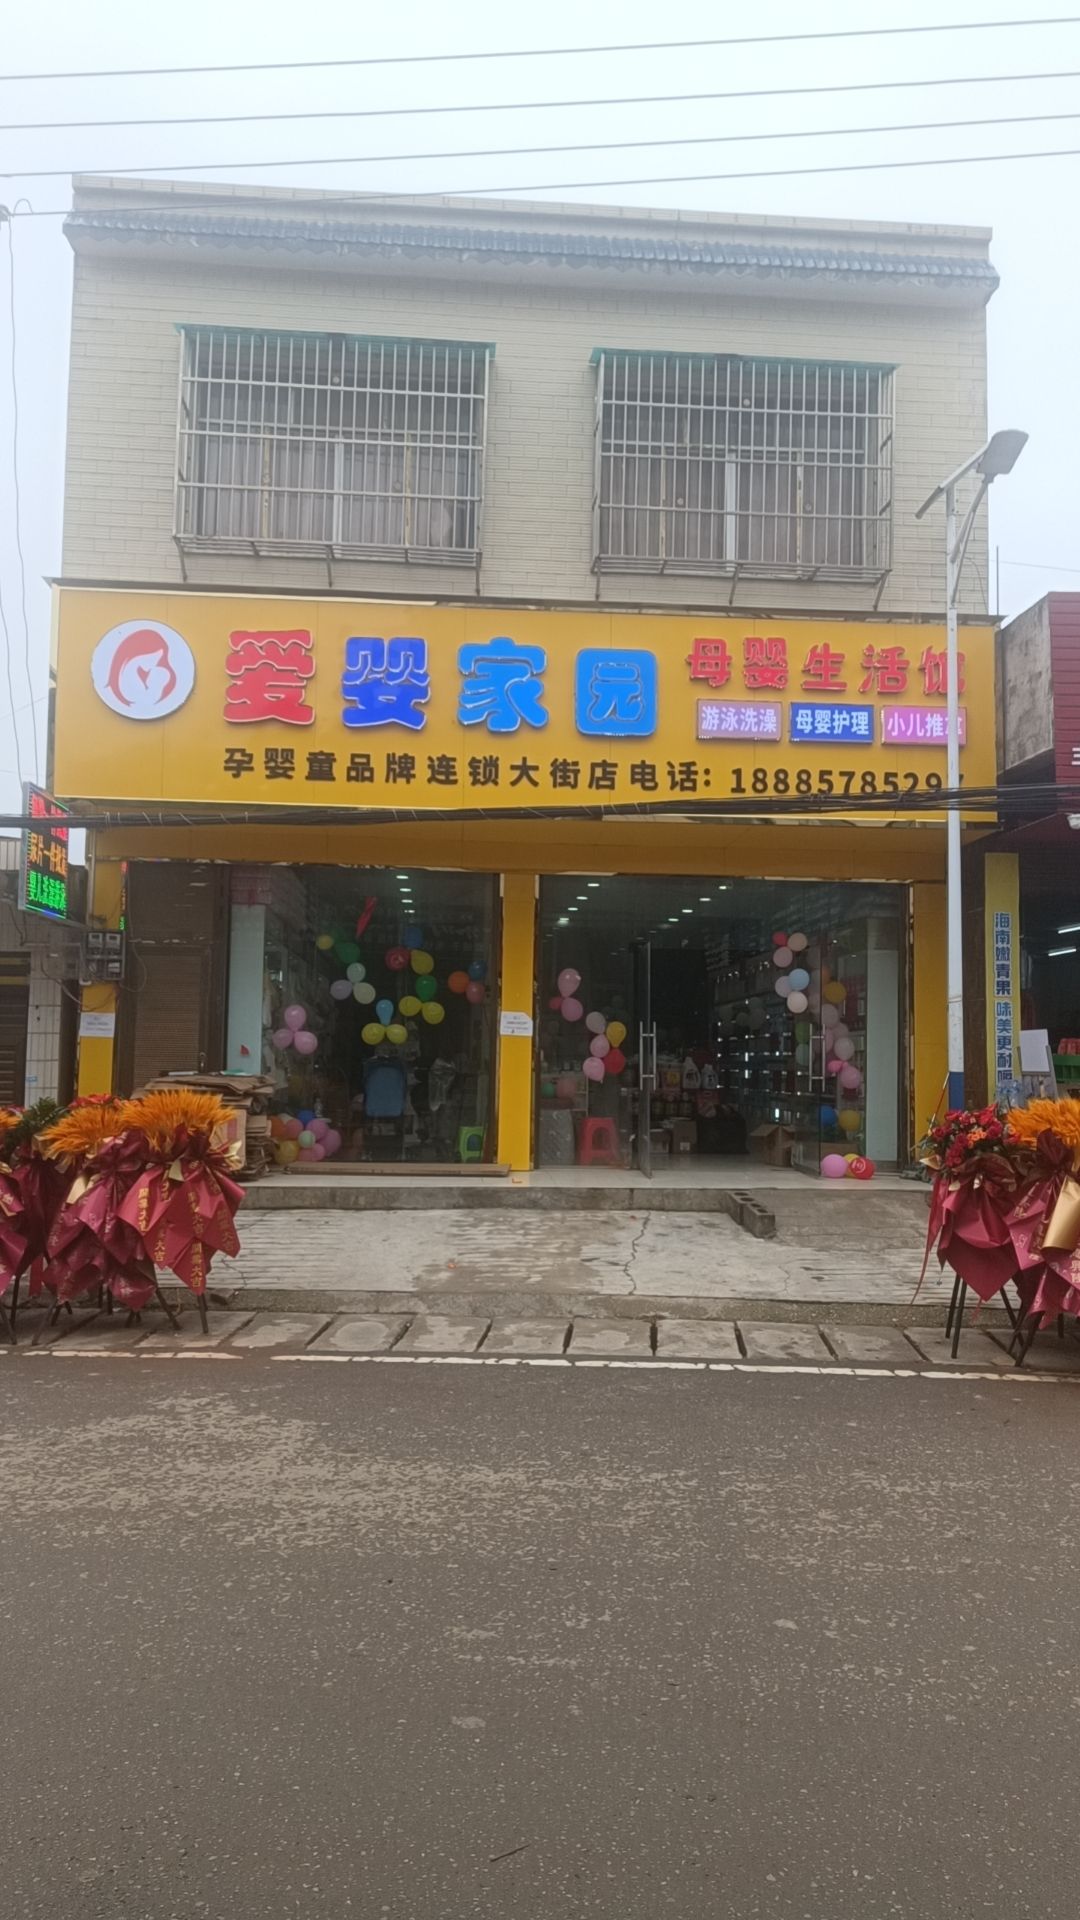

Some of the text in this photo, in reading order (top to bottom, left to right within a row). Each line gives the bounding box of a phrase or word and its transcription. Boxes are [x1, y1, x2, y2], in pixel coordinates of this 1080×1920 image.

[222, 628, 658, 737] 爱婴家园
[685, 636, 966, 696] 母婴生活馆
[701, 705, 777, 733] 游泳洗澡
[795, 709, 870, 735] 母婴护理
